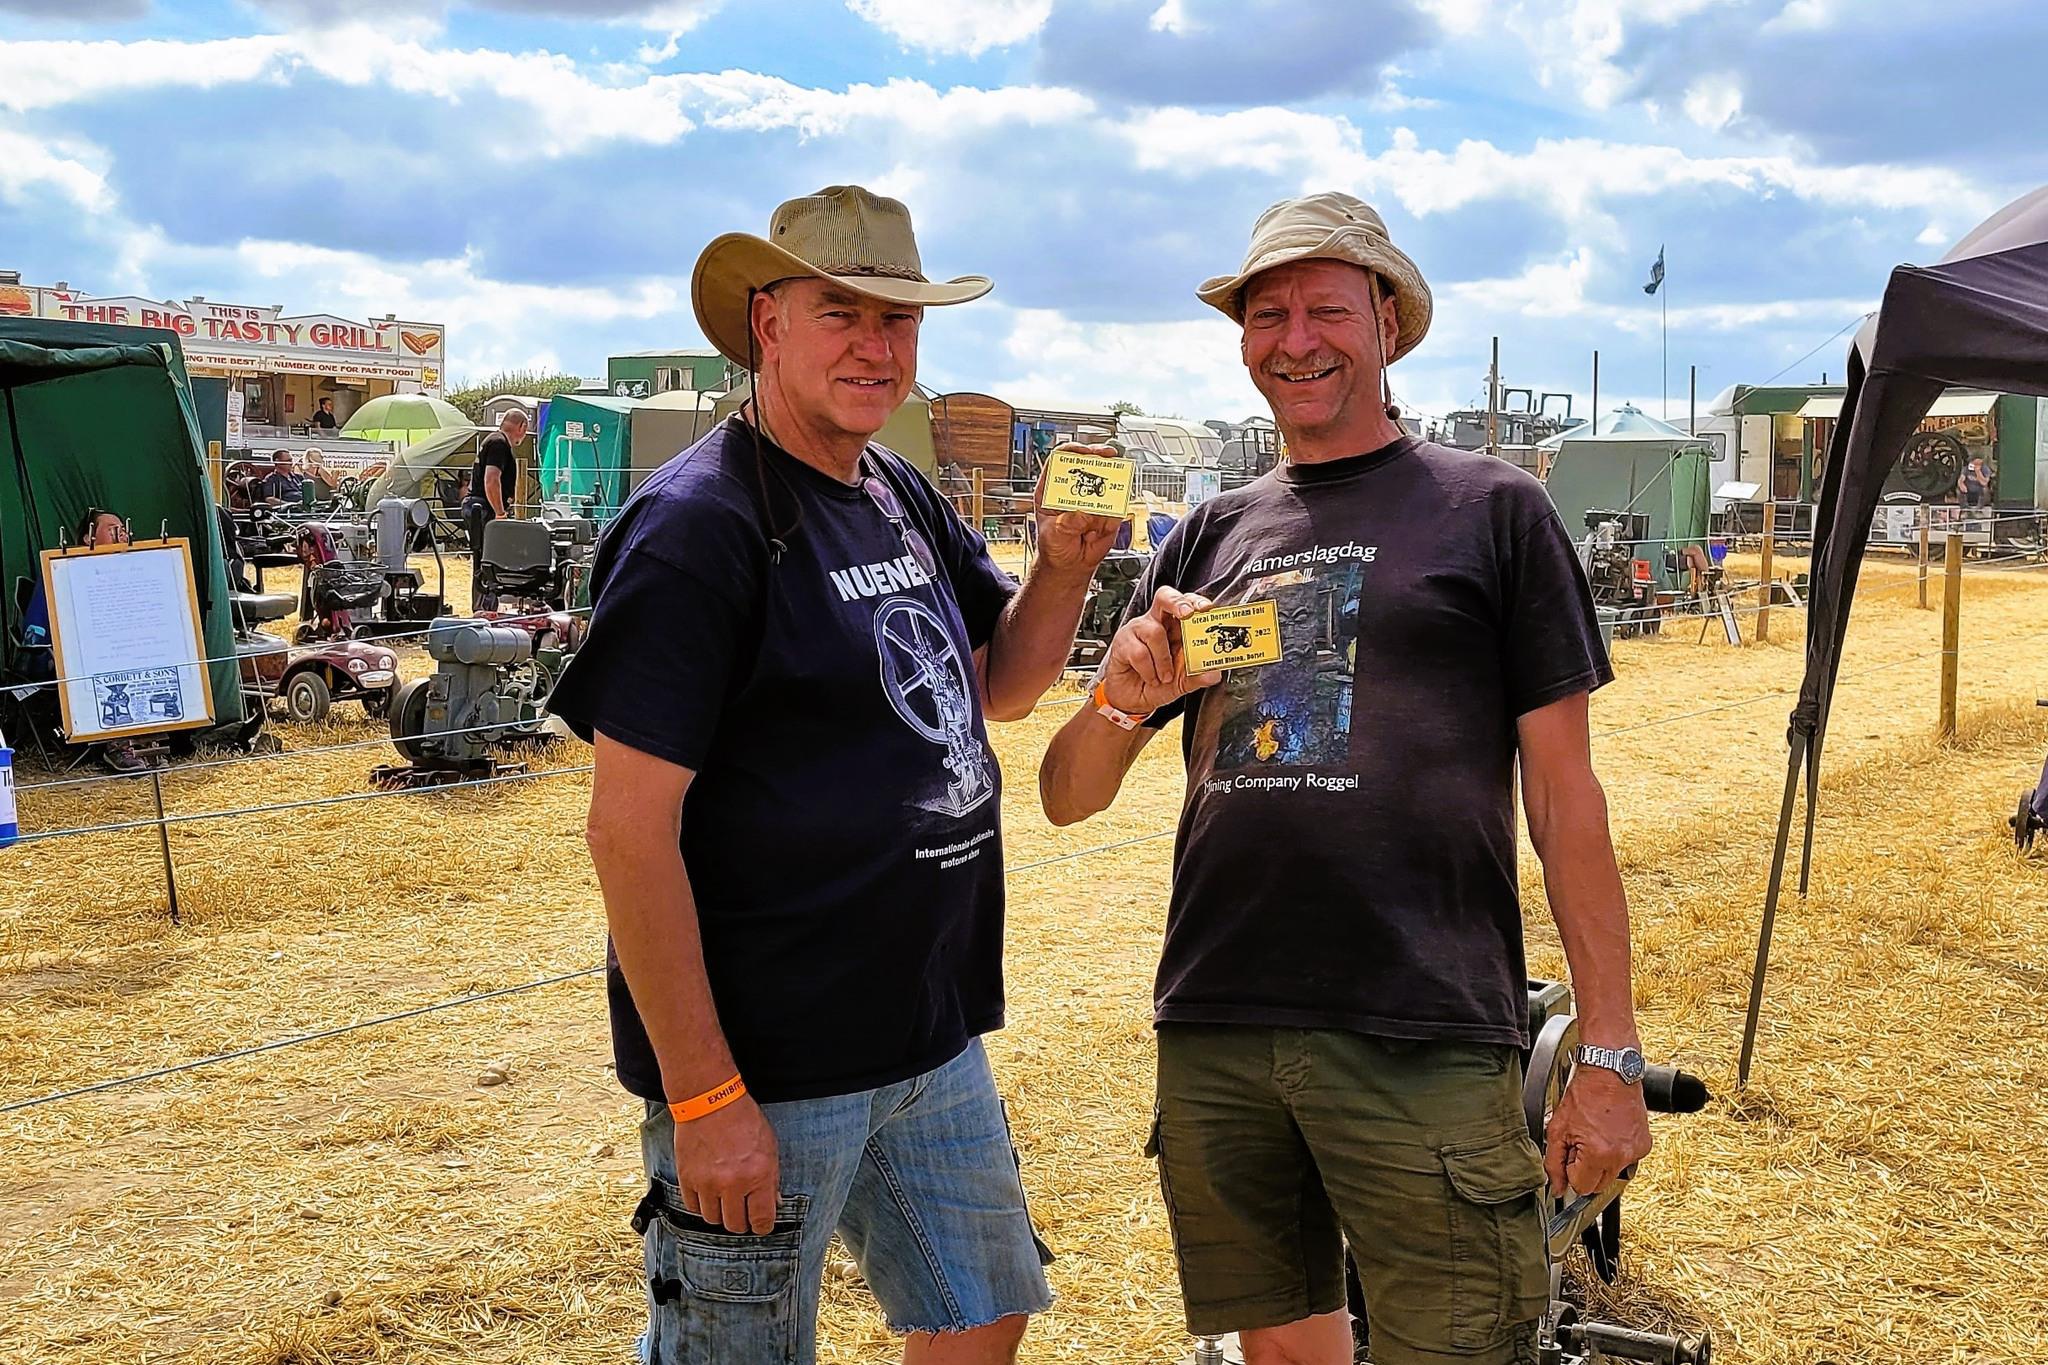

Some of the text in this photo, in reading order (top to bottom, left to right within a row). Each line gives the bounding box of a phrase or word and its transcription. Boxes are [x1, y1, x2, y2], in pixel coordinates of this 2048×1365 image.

[208, 306, 260, 320] THIS IS
[59, 304, 393, 353] THE BIG TASTY GRILL
[206, 355, 228, 364] THE
[230, 357, 257, 366] BEST
[273, 360, 414, 377] NUMBER ONE FOR FAST FOOD!
[422, 381, 440, 390] Order
[333, 460, 360, 470] BIGGEST
[1059, 455, 1125, 470] Great Dorset Steam Fair
[1053, 475, 1069, 484] 52nd
[1108, 482, 1124, 491] 2022
[828, 555, 932, 602] NUENE
[1191, 606, 1265, 625] Great Dorset Steam Fair
[1254, 627, 1271, 637] 2022
[1191, 638, 1209, 648] 52nd
[1202, 658, 1224, 668] Tarrant
[1246, 651, 1265, 661] Dorset
[103, 671, 143, 684] CORBETT
[144, 671, 151, 679] &
[1203, 772, 1360, 795] Mining Company Roggel
